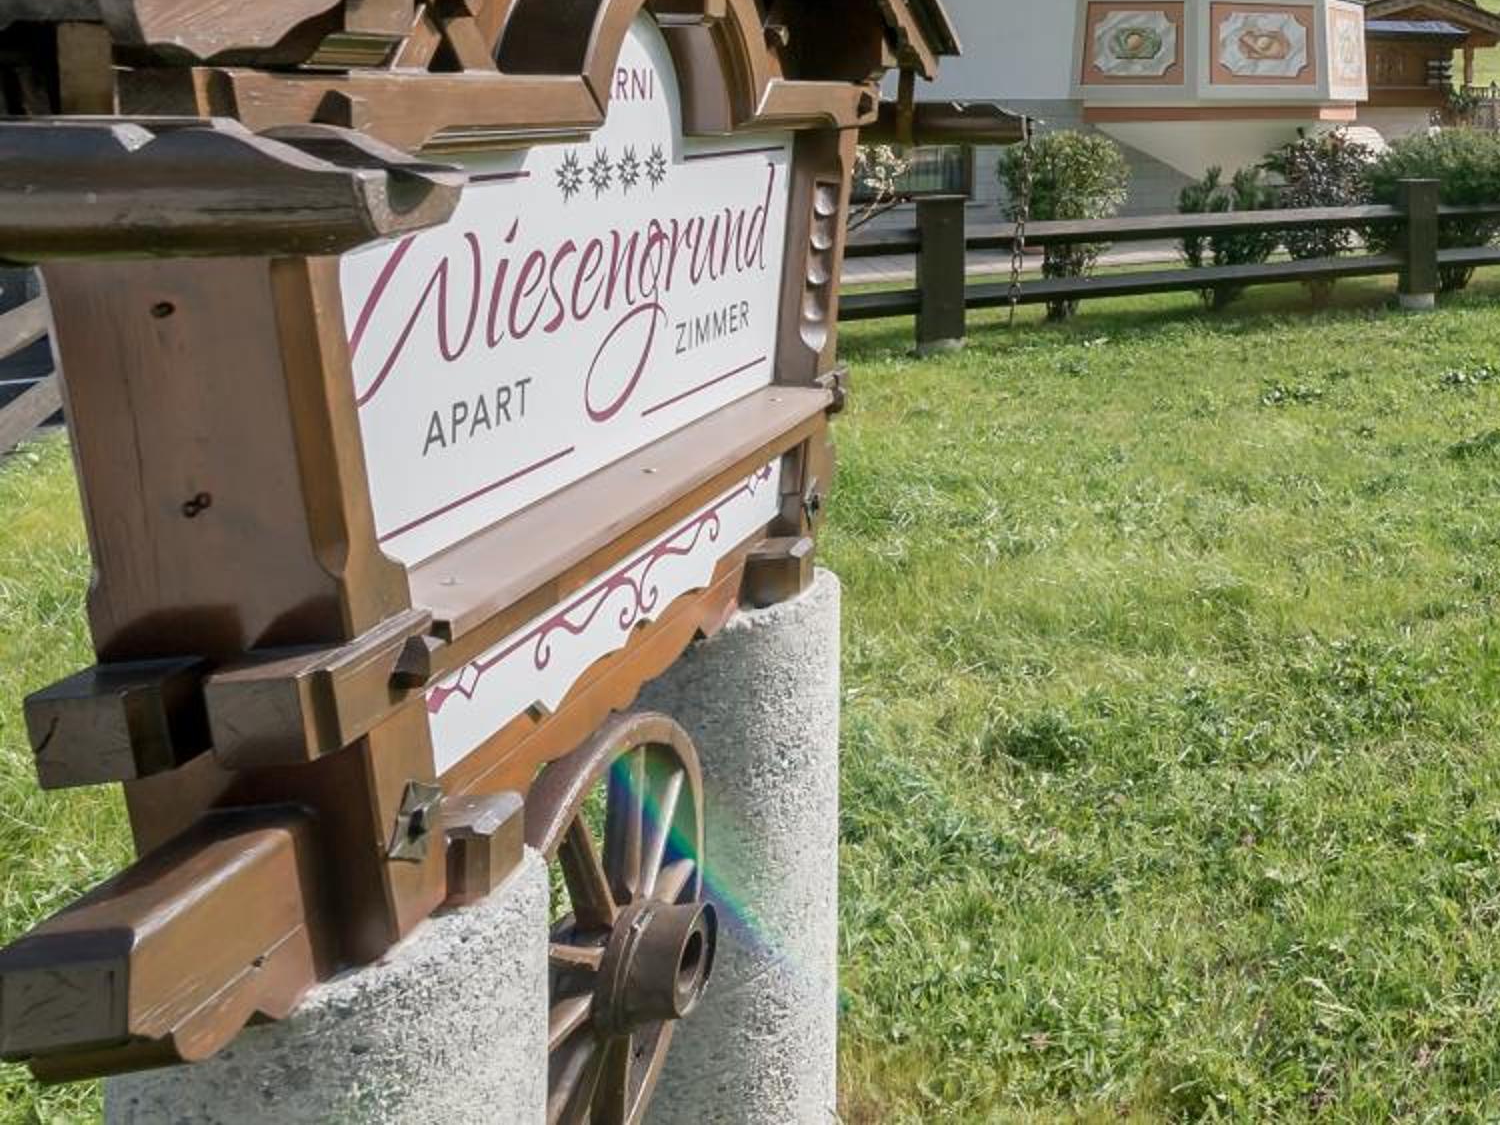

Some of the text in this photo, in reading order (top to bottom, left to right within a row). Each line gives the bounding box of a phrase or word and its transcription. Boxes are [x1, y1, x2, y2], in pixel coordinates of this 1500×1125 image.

[609, 67, 653, 101] RNI
[349, 162, 775, 423] Wiesengrund
[675, 301, 750, 354] ZIMMER
[422, 378, 532, 457] APART
